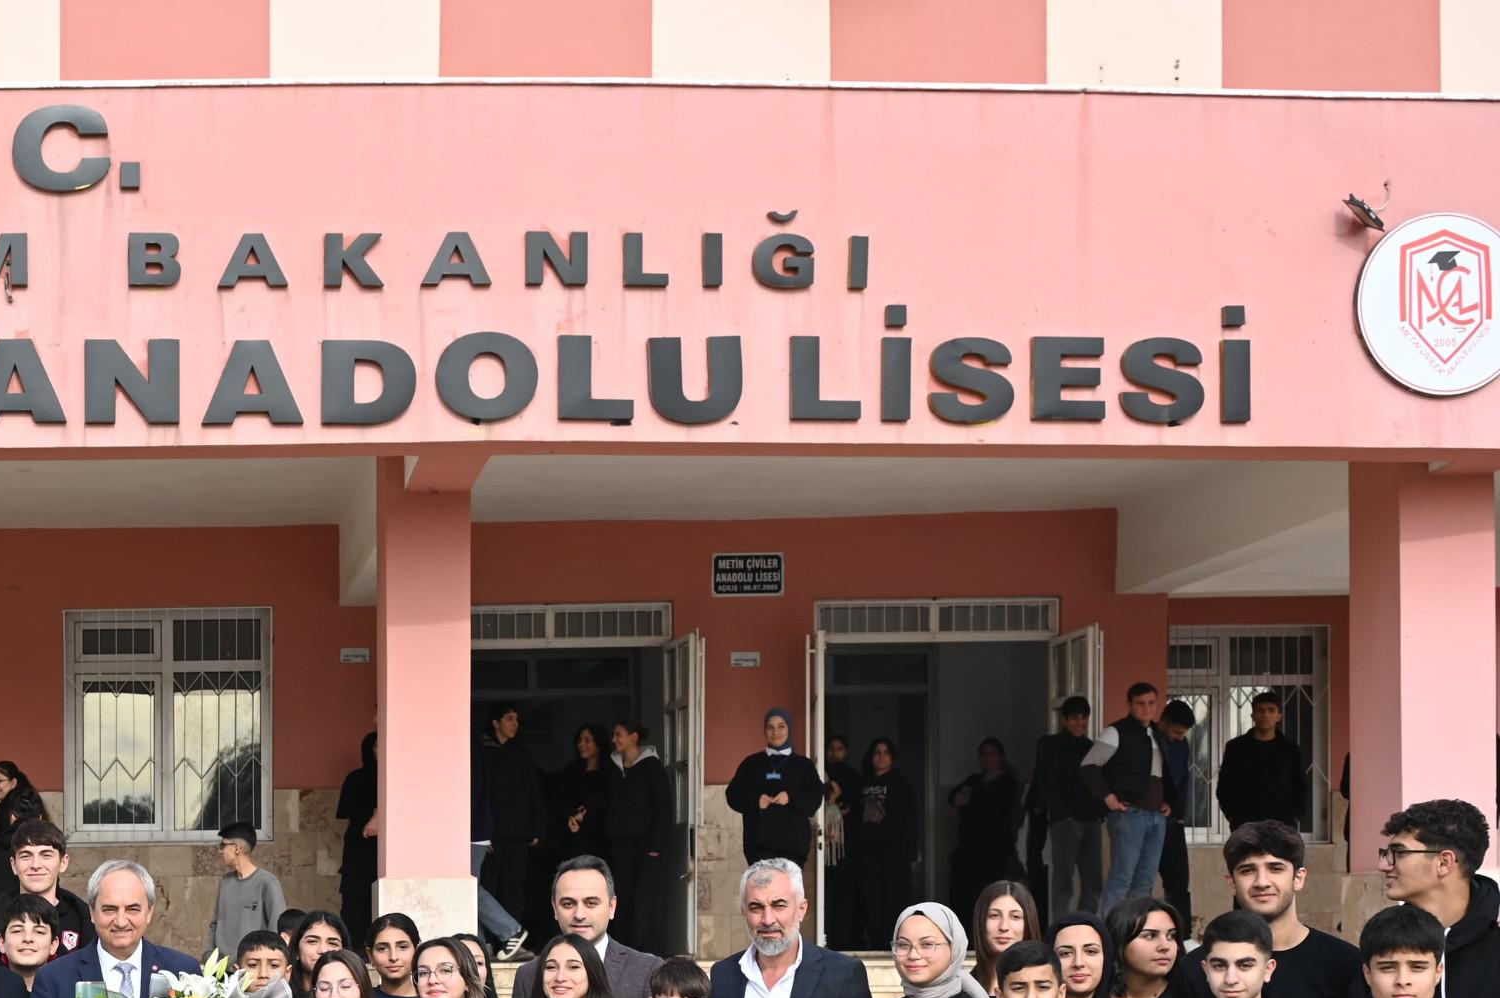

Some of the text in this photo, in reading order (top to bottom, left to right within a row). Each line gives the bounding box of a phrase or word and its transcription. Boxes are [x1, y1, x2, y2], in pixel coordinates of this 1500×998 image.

[12, 104, 141, 194] C.
[128, 209, 870, 290] BAKANLIĞI
[789, 304, 1251, 426] LİSESİ
[1434, 338, 1457, 348] 2005
[715, 570, 781, 583] ANADOLU LİSESİ
[718, 556, 779, 571] METİN ÇİVİLER
